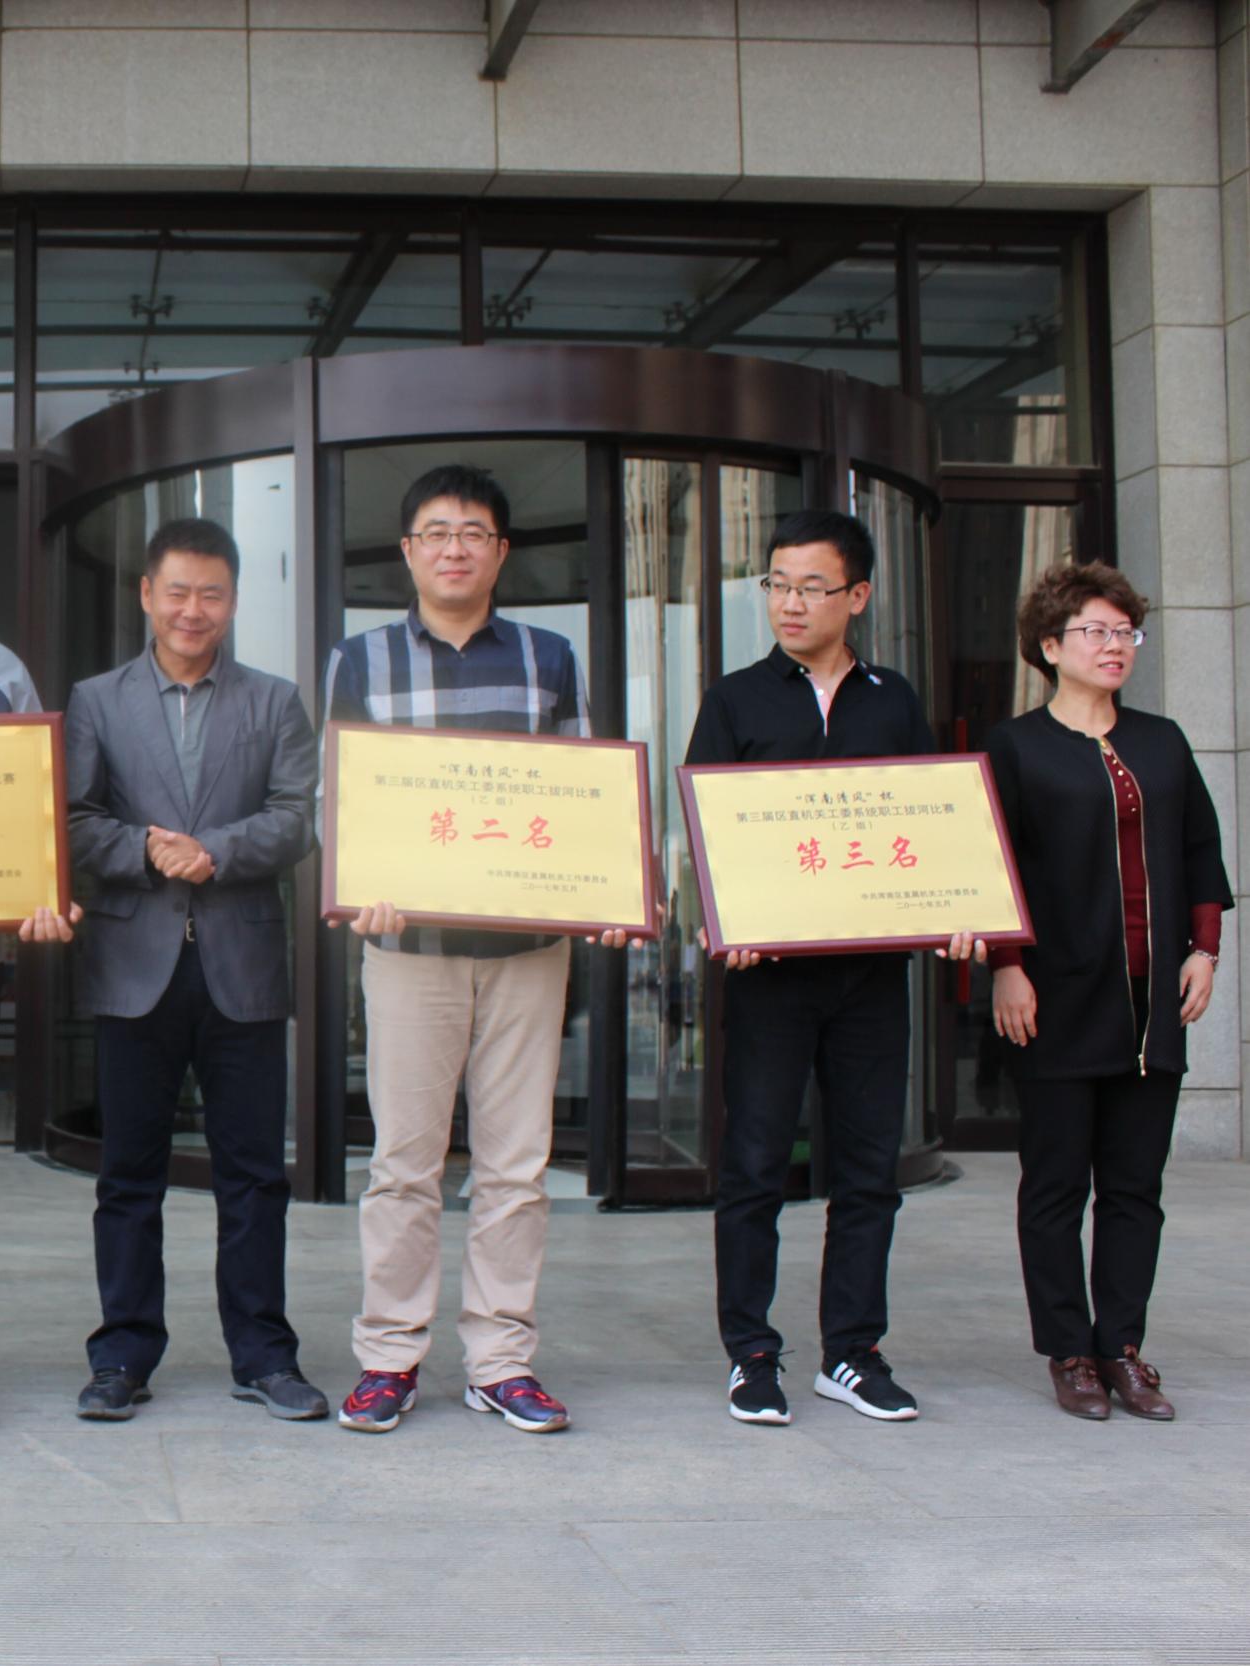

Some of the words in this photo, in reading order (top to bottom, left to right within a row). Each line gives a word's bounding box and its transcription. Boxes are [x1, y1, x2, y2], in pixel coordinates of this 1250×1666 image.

[429, 807, 554, 849] 第二名
[796, 835, 919, 876] 第三名
